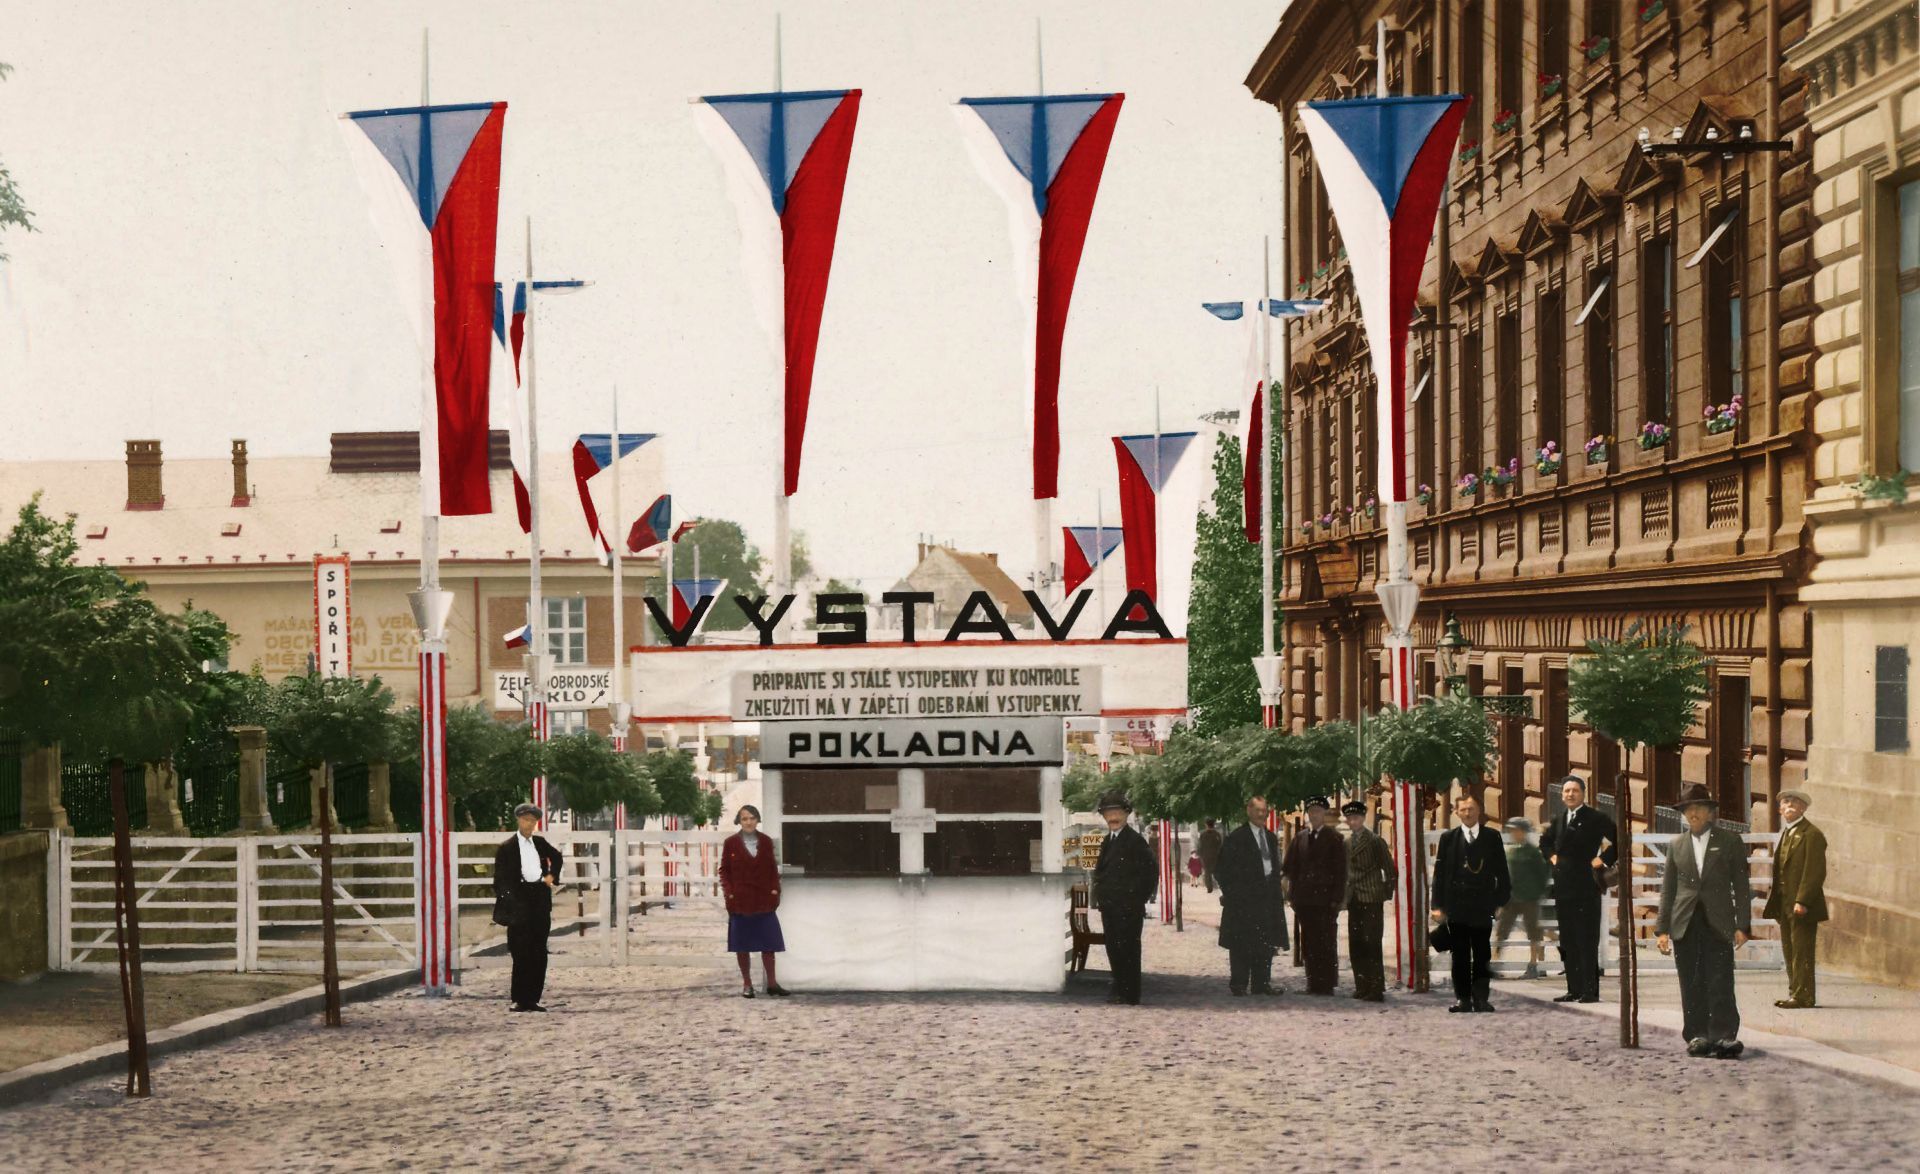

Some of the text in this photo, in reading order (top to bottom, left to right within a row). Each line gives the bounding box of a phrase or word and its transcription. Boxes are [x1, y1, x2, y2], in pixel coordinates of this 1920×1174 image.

[643, 588, 1175, 647] VYSTAVA
[753, 668, 1080, 691] PŘIPRAVTE SI STÁLÉ VSTUPENKY KU KONTROLE
[548, 690, 586, 703] KLO
[745, 695, 810, 717] ZNEUŽITÍ
[816, 694, 835, 715] MÁ
[842, 698, 851, 714] V
[860, 692, 909, 715] ZÁPĚTÍ
[918, 691, 989, 714] ODEBRÁNÍ
[789, 731, 1035, 758] POKLADNA
